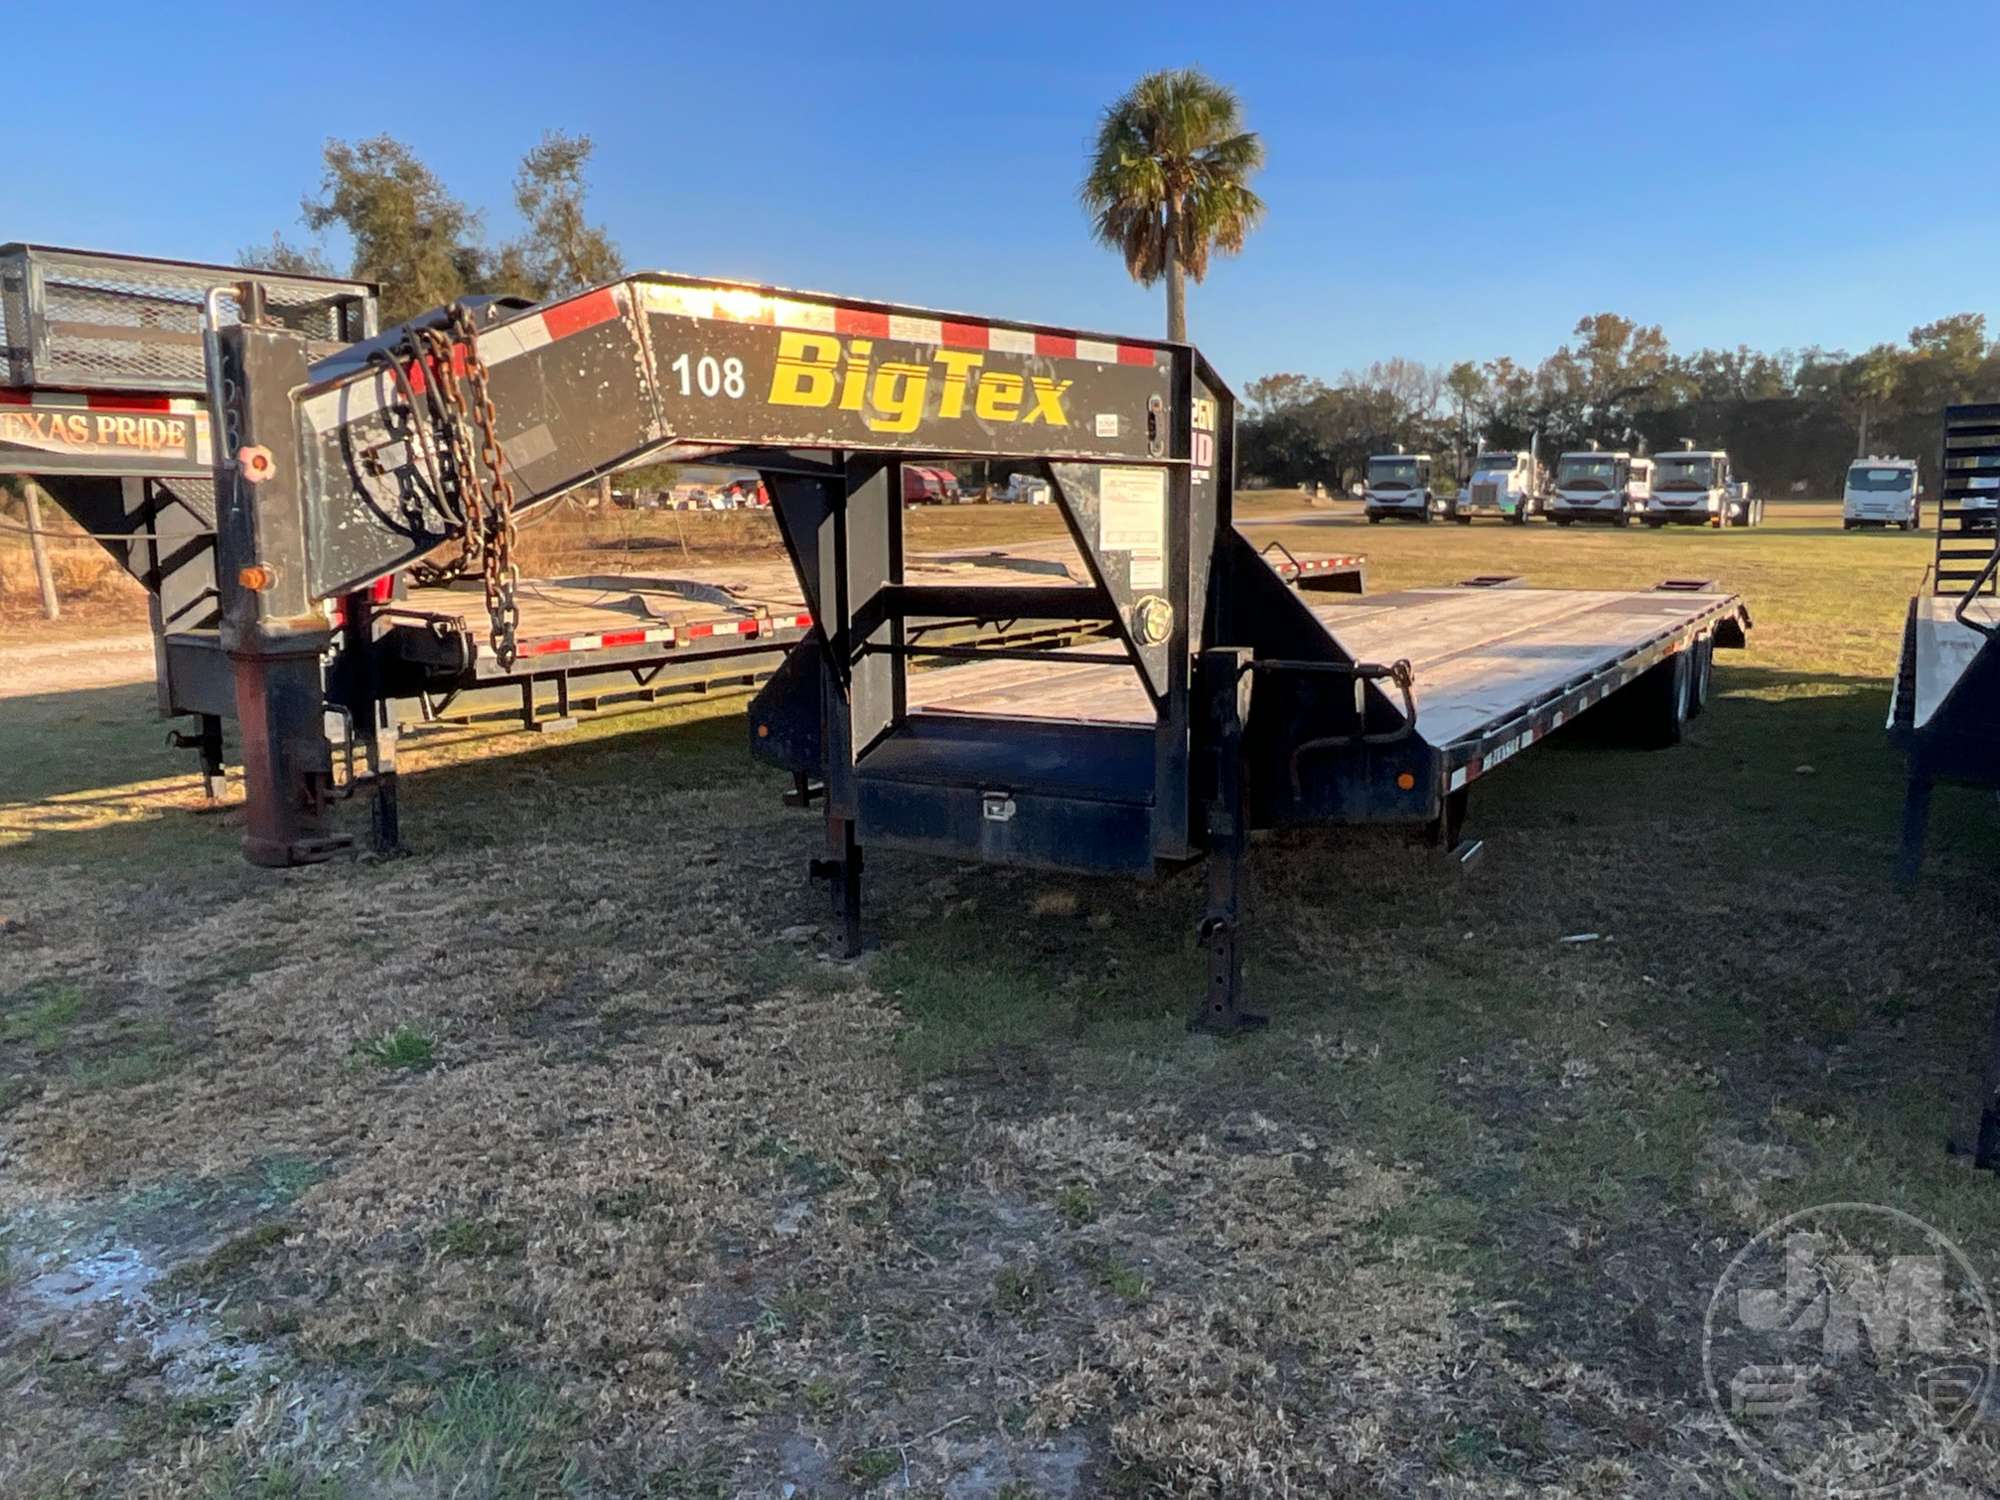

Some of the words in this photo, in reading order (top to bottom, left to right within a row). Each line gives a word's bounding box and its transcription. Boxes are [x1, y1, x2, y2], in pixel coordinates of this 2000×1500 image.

[671, 353, 746, 399] 108
[767, 330, 1073, 433] BigTex
[0, 411, 90, 448] EXAS
[96, 415, 186, 451] PRIDE
